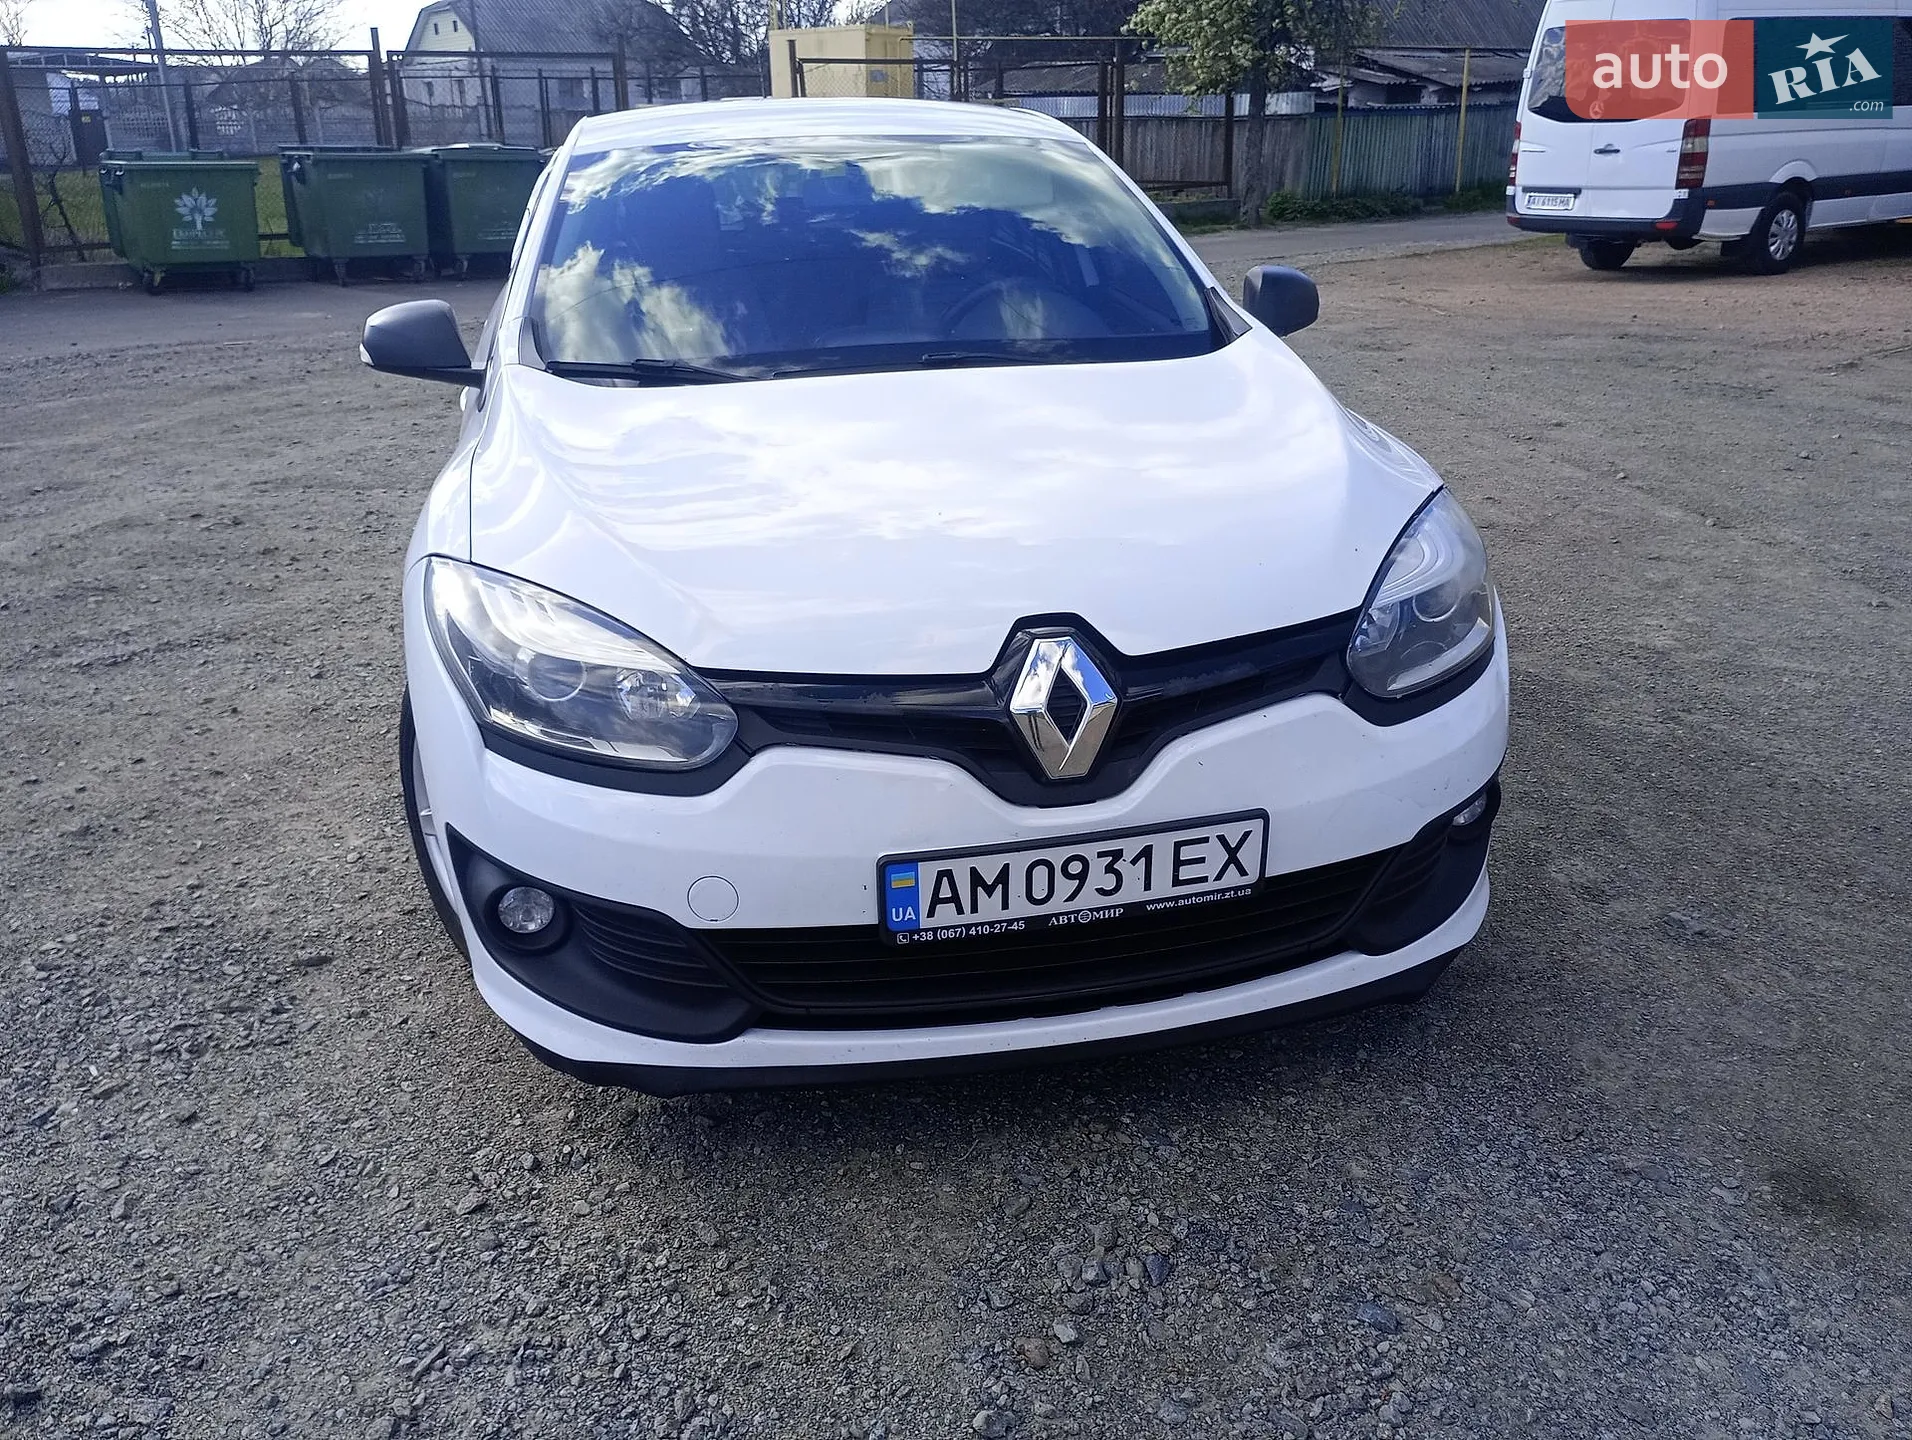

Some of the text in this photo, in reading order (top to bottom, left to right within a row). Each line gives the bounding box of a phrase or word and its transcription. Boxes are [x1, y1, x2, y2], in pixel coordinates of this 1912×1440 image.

[927, 830, 1252, 918] AM 0931 EX
[1146, 888, 1252, 911] www.automir.zt.ua
[892, 906, 916, 922] UA
[912, 920, 1025, 941] +38 (067) 410-27-45
